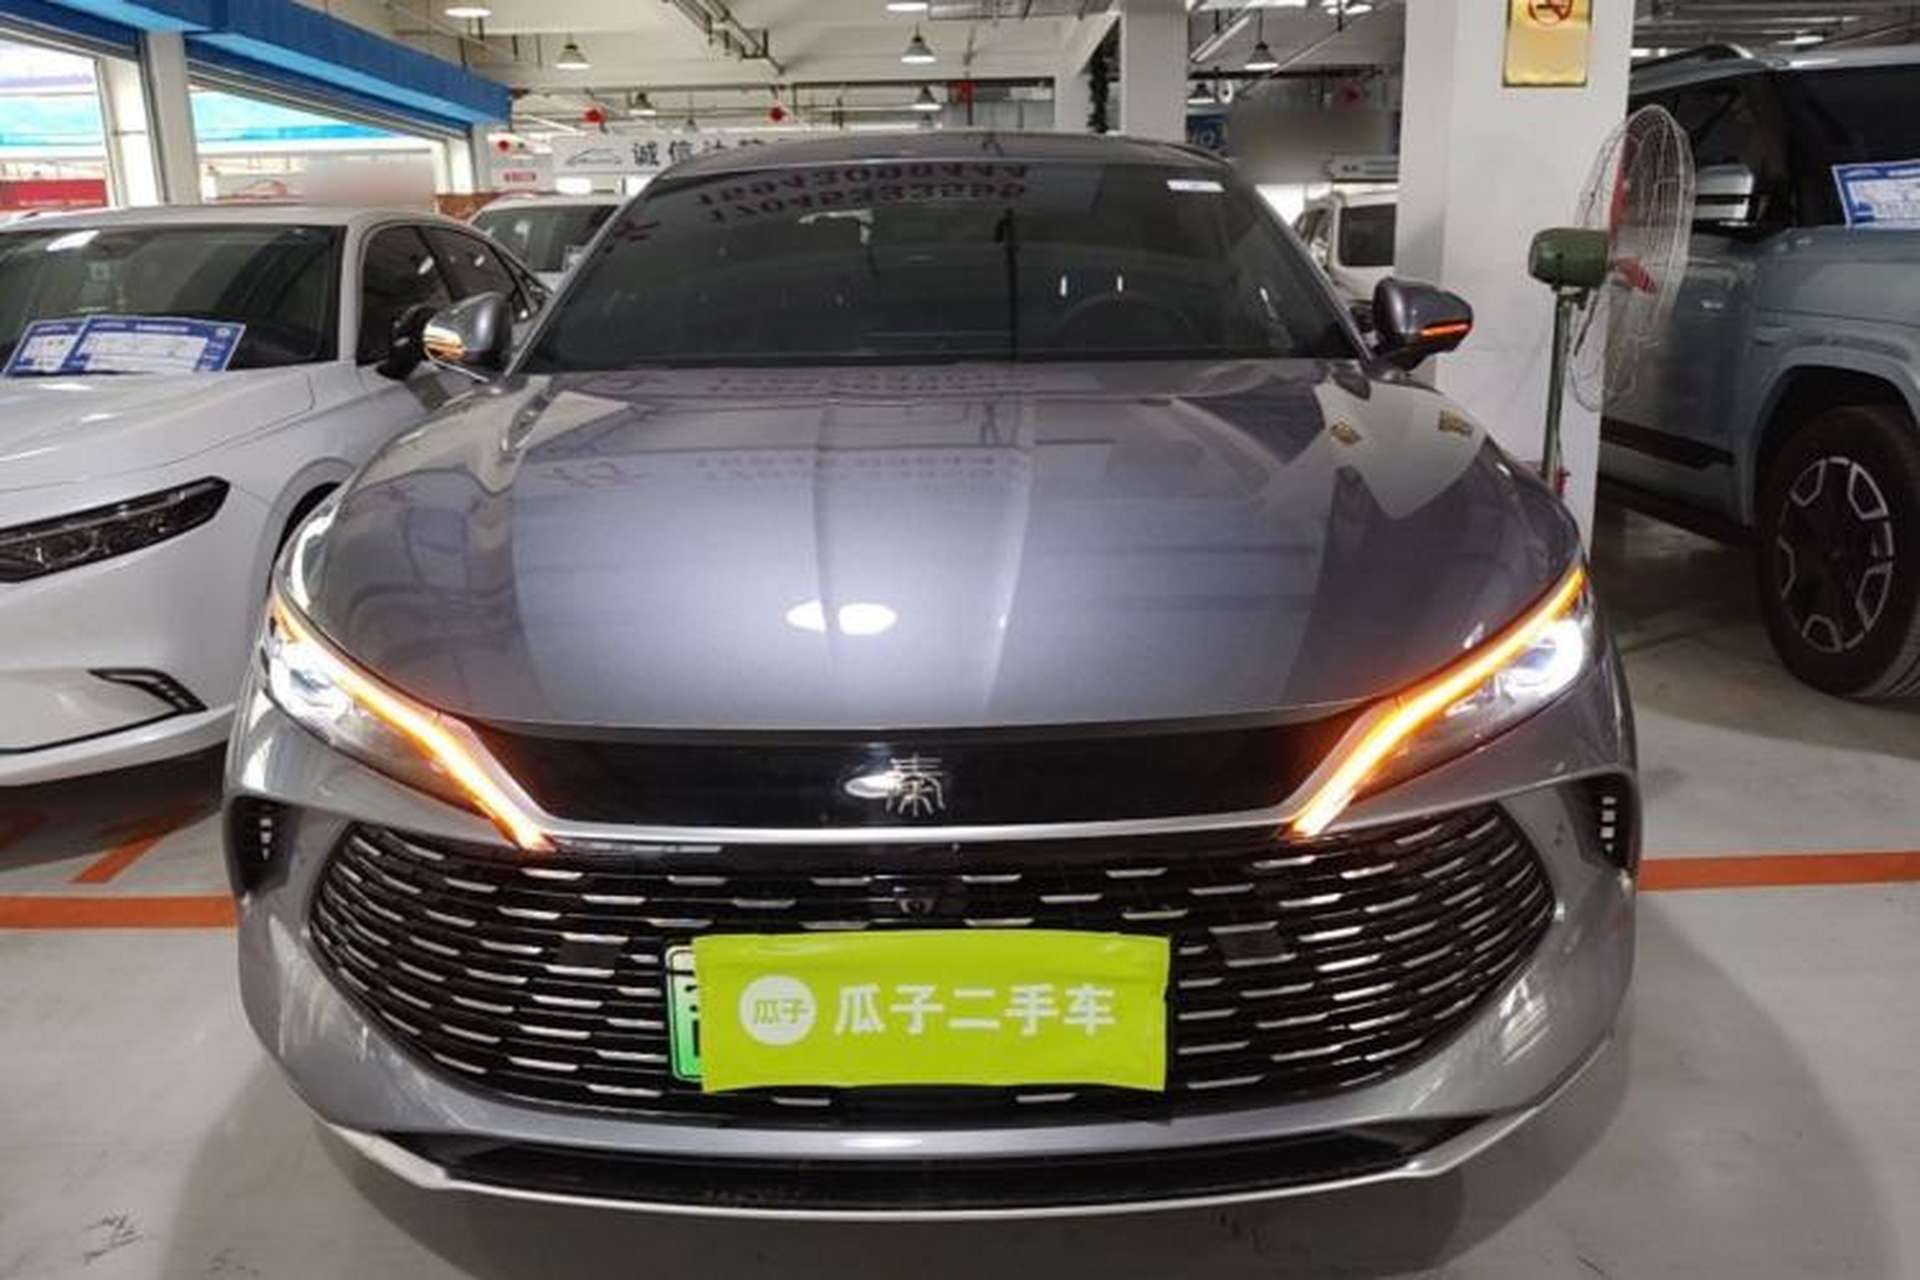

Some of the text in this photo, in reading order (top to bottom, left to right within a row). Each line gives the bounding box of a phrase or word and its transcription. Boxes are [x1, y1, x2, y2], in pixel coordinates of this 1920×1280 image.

[834, 983, 1115, 1036] 瓜子二手车
